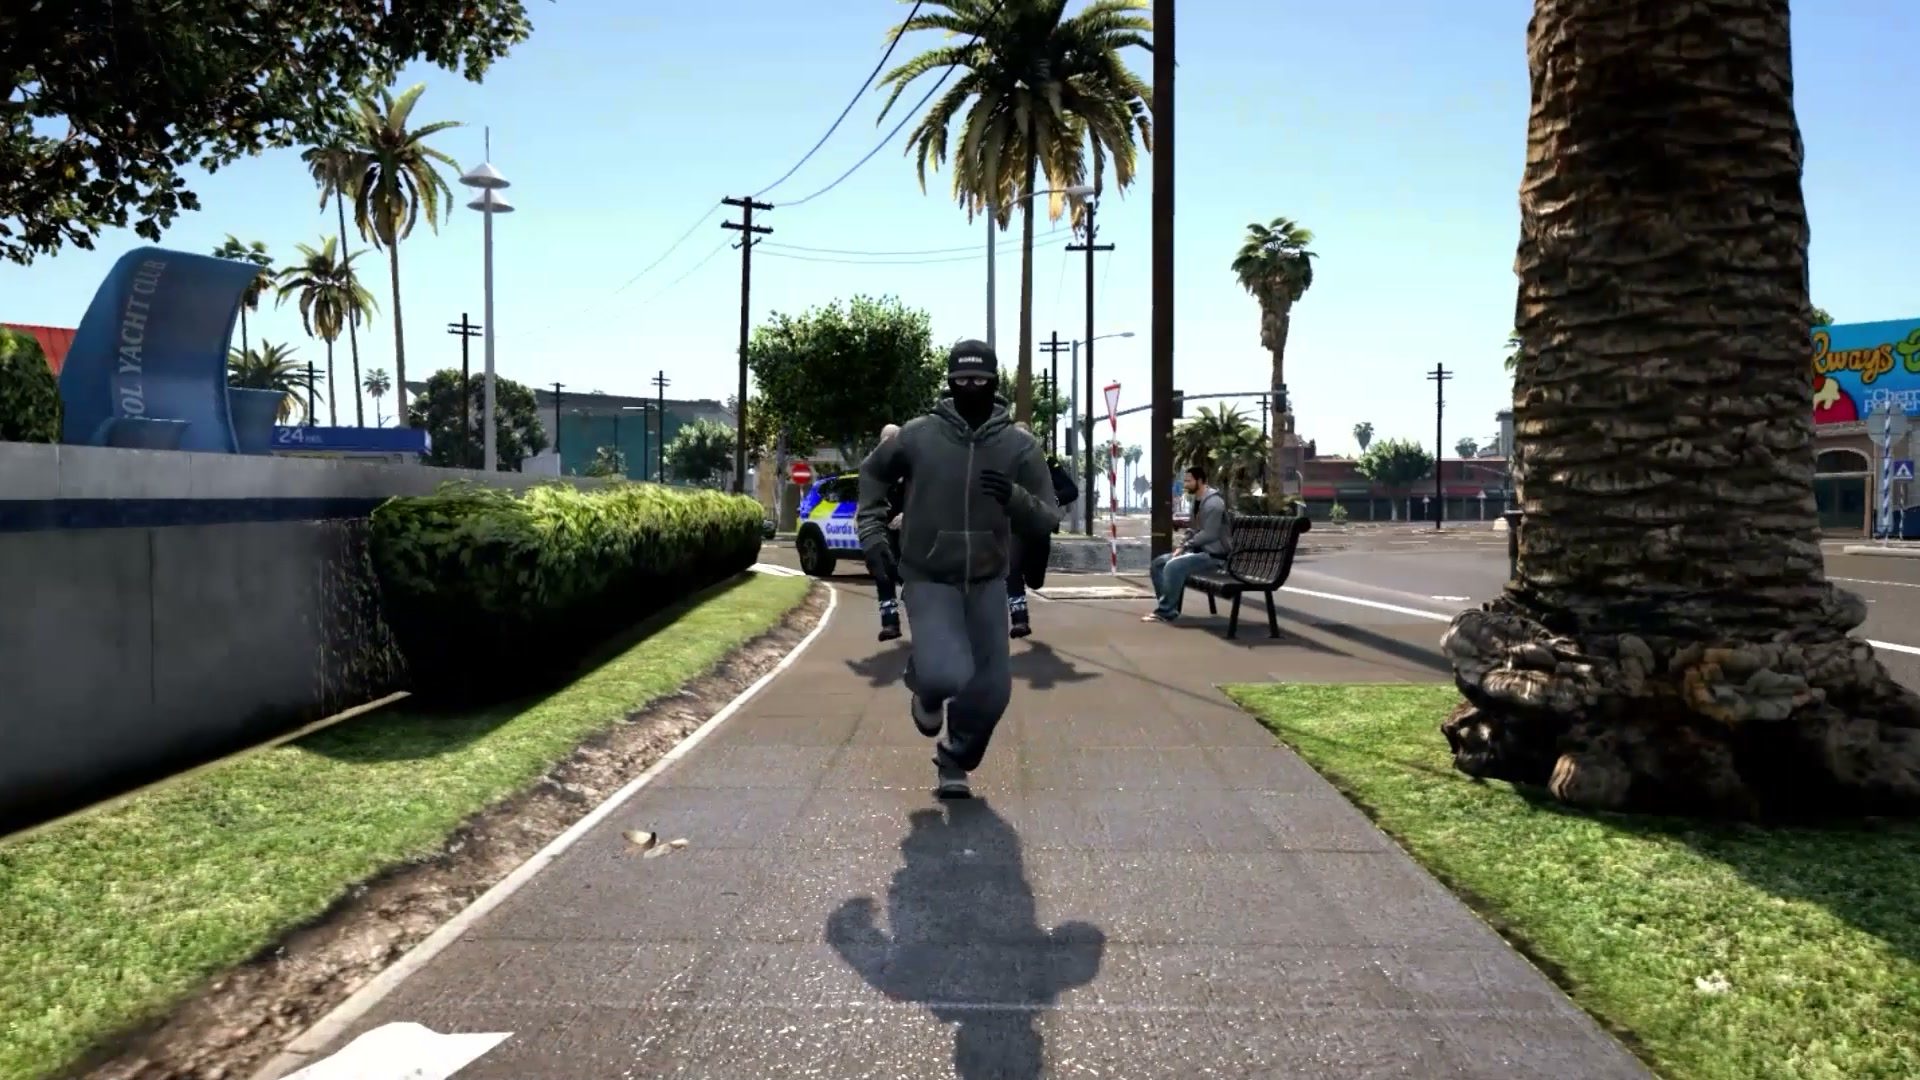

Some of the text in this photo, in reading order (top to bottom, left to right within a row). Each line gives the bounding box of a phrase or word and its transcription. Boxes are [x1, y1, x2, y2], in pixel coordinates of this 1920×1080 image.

[119, 259, 168, 419] OL YACHT CLUB
[1812, 331, 1896, 384] lways
[279, 428, 304, 443] 24
